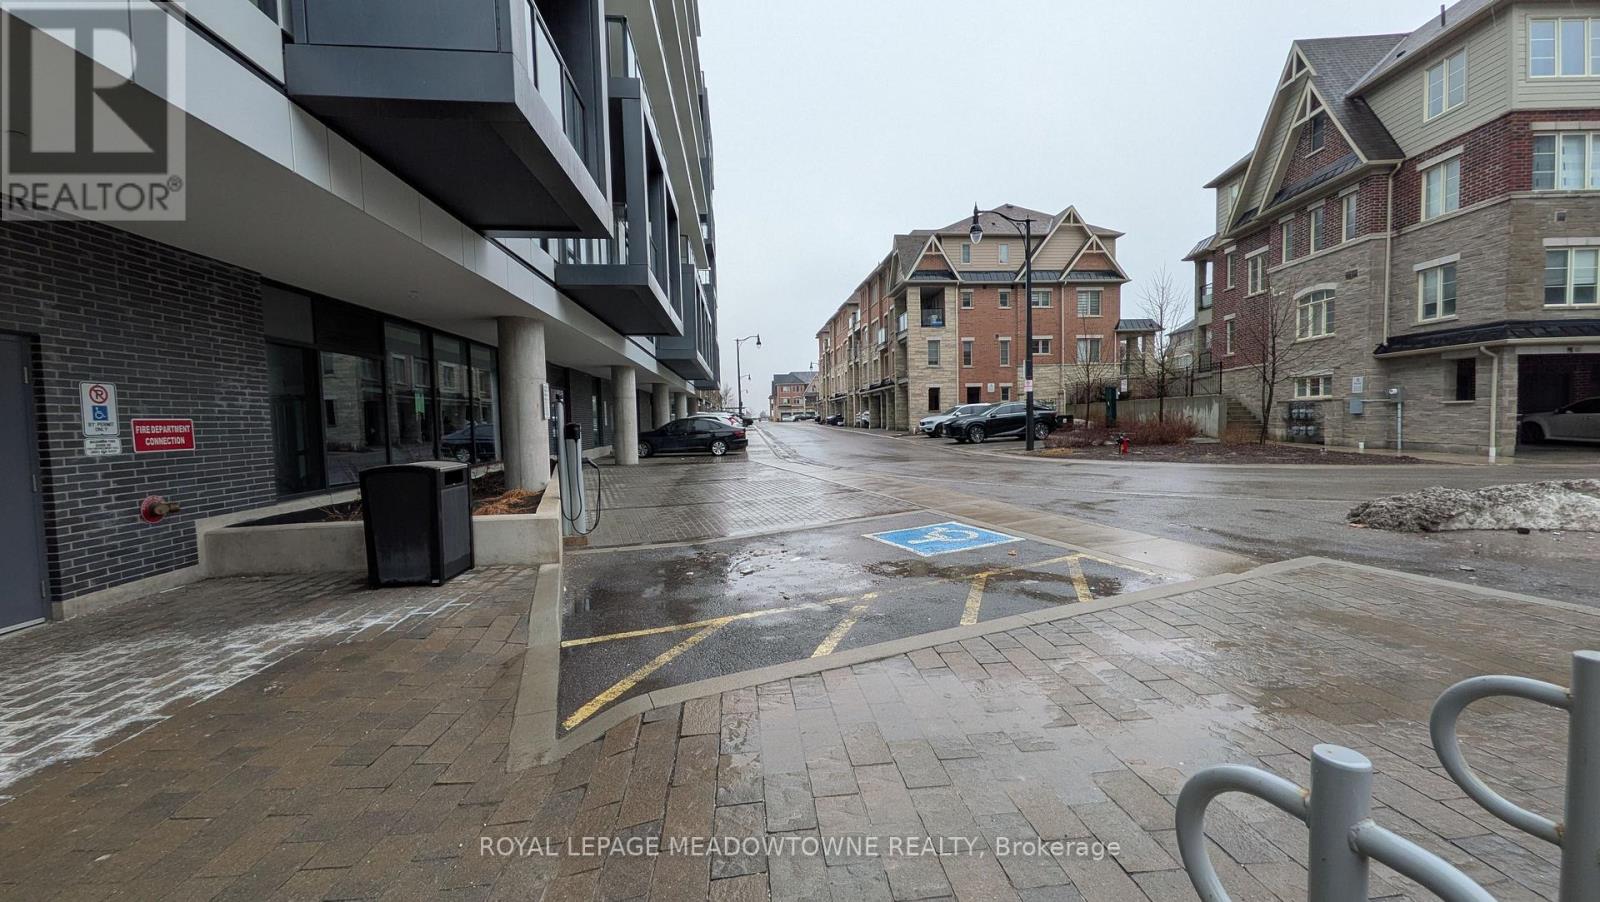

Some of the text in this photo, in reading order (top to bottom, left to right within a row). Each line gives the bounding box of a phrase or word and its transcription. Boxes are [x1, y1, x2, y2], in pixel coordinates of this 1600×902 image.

[135, 424, 191, 434] FIRE DEPARTMENT
[145, 436, 186, 446] CONNECTION
